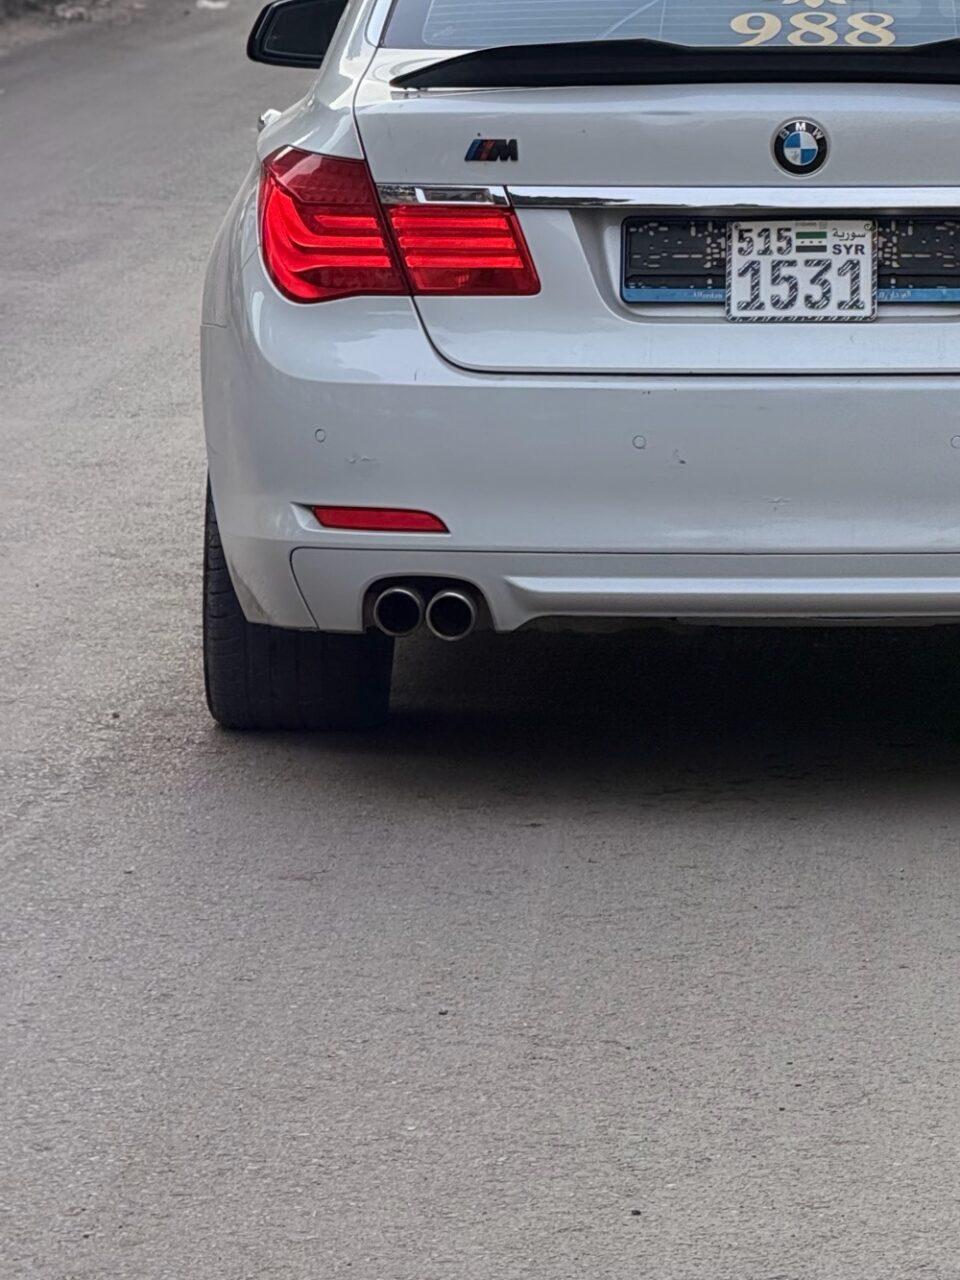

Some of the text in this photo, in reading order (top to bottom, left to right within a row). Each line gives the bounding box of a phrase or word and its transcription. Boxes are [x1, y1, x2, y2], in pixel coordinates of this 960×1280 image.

[729, 11, 896, 46] 988
[737, 227, 792, 256] 515
[831, 227, 866, 241] سورية
[831, 243, 866, 255] SYR
[737, 259, 865, 311] 1531
